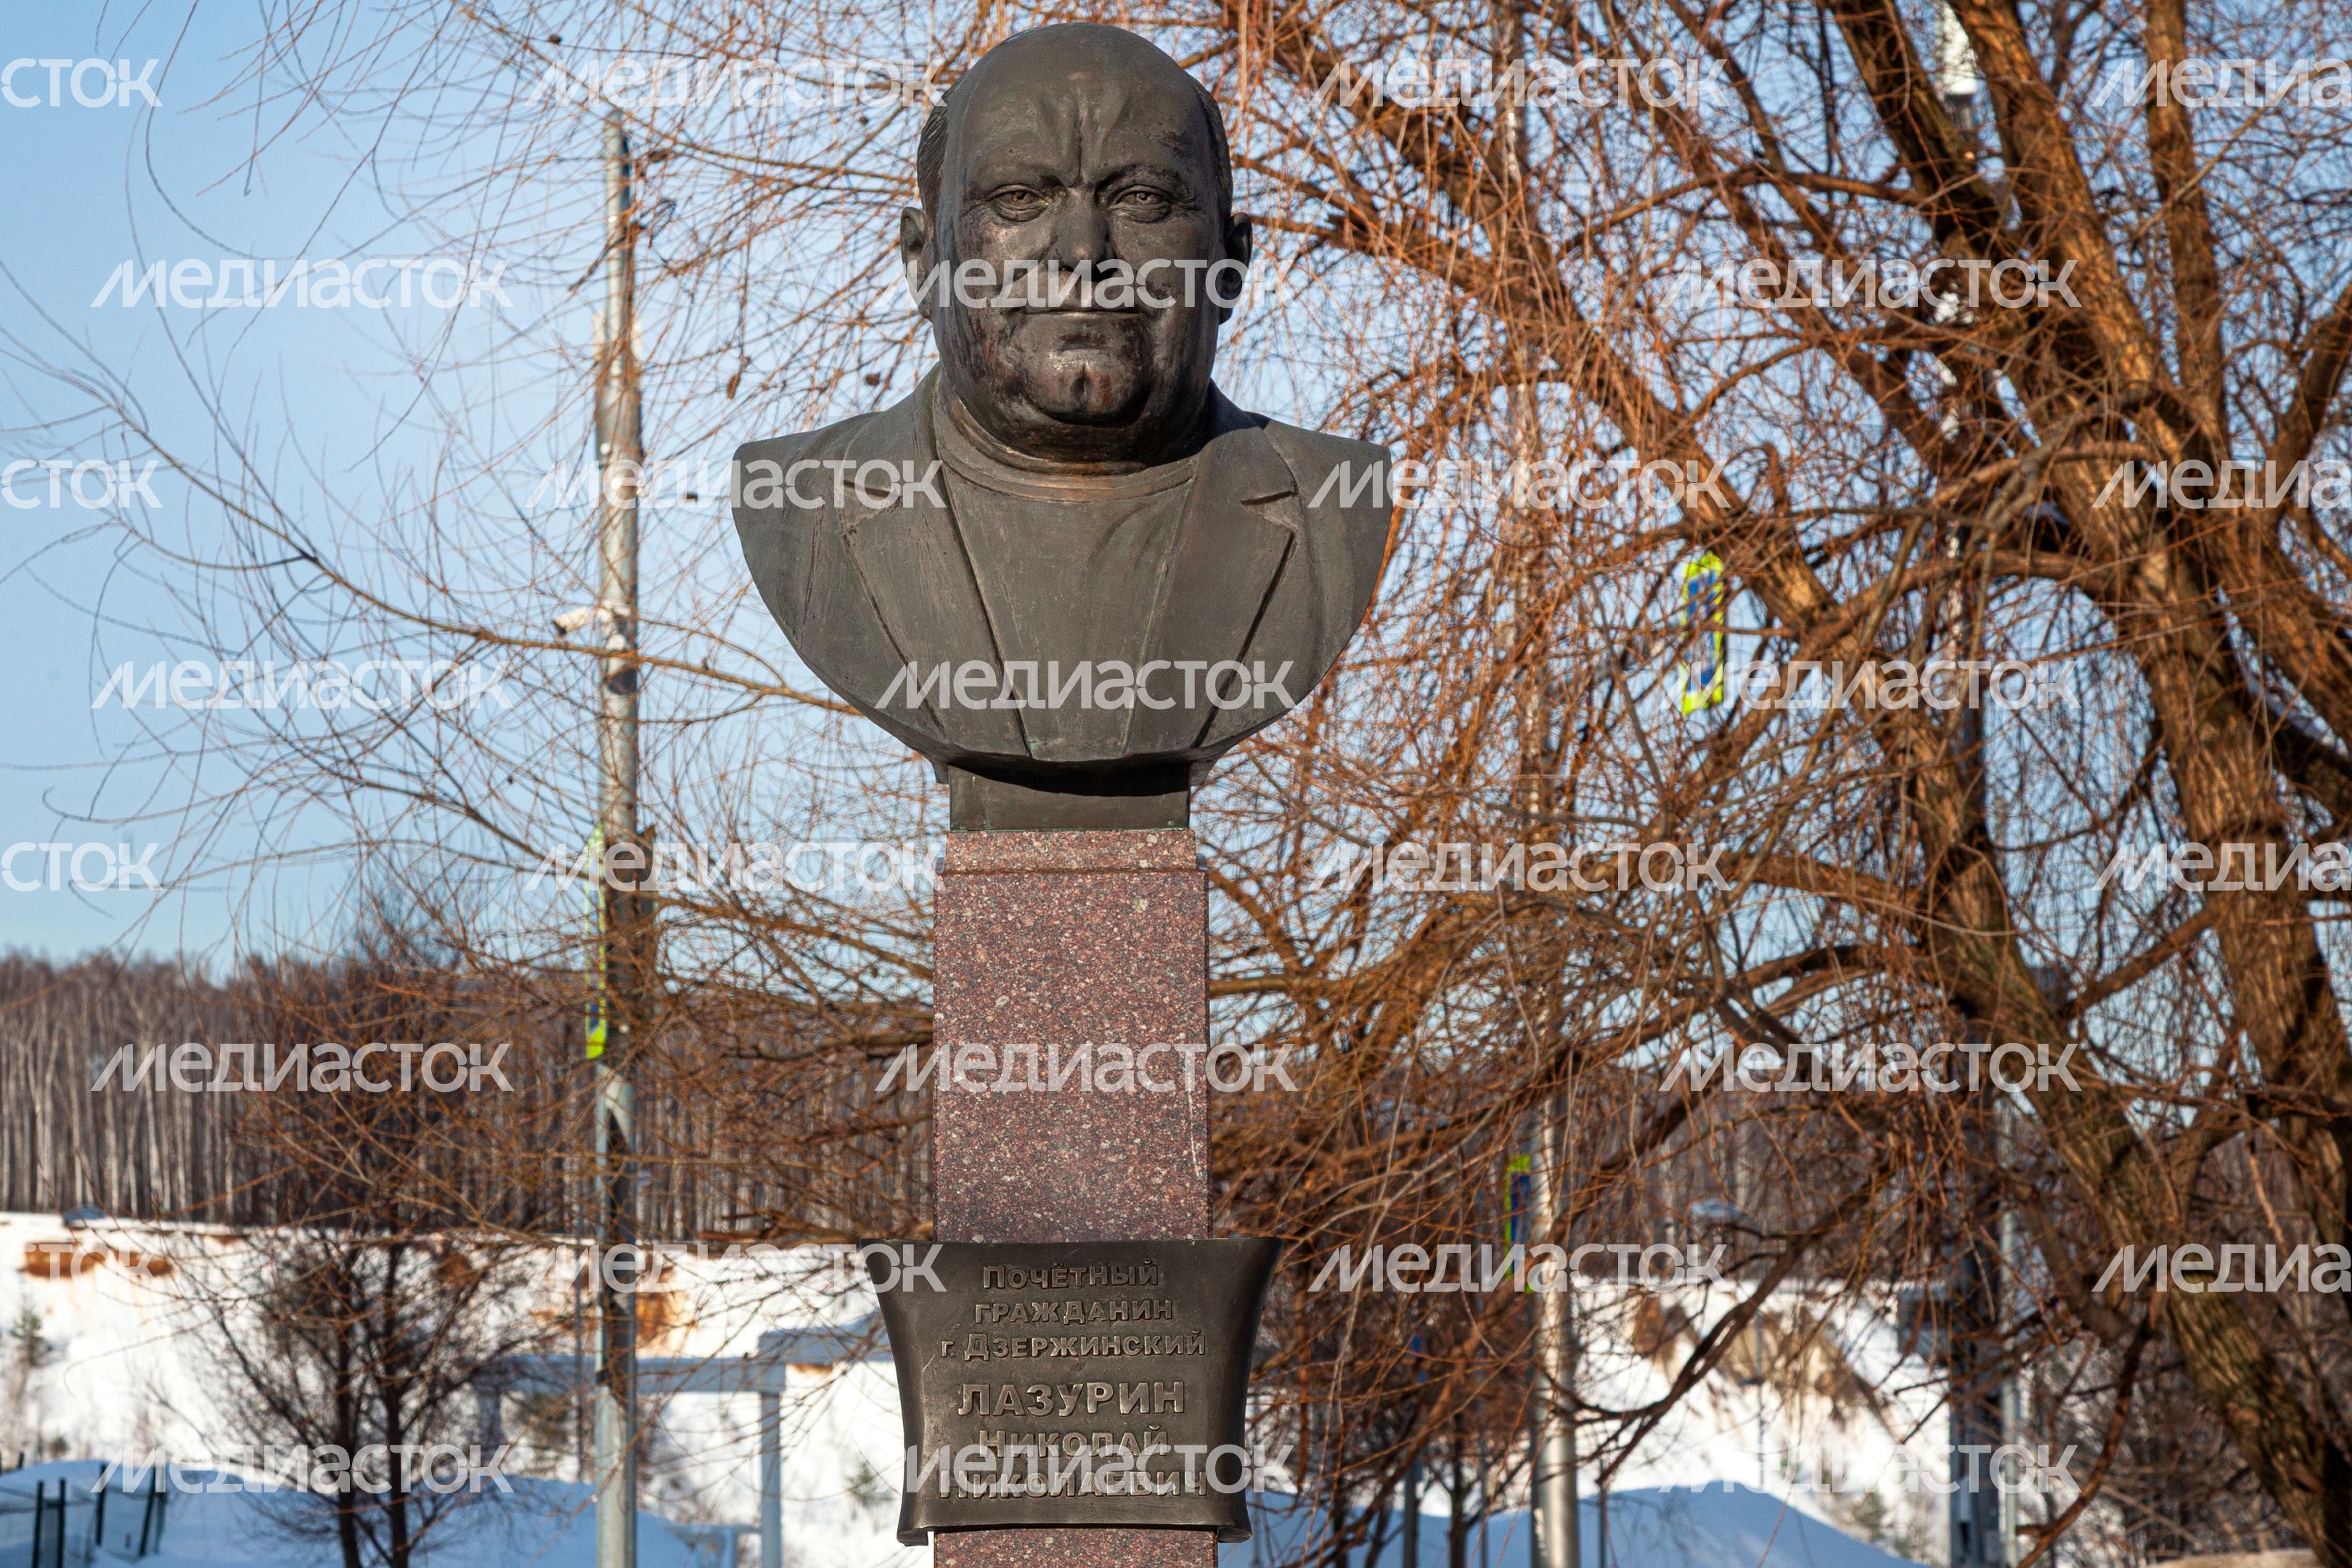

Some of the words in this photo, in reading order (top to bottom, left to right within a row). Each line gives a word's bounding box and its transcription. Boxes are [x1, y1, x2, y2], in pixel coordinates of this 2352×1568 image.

[983, 1260, 1159, 1289] ПОЧЁТНЫЙ
[941, 1340, 956, 1358] г.
[963, 1330, 1206, 1362] ДЗЕРЖИНСКИЙ
[957, 1382, 1185, 1417] ЛАЗУРИН
[979, 1425, 1168, 1458] НИКОЛАЙ
